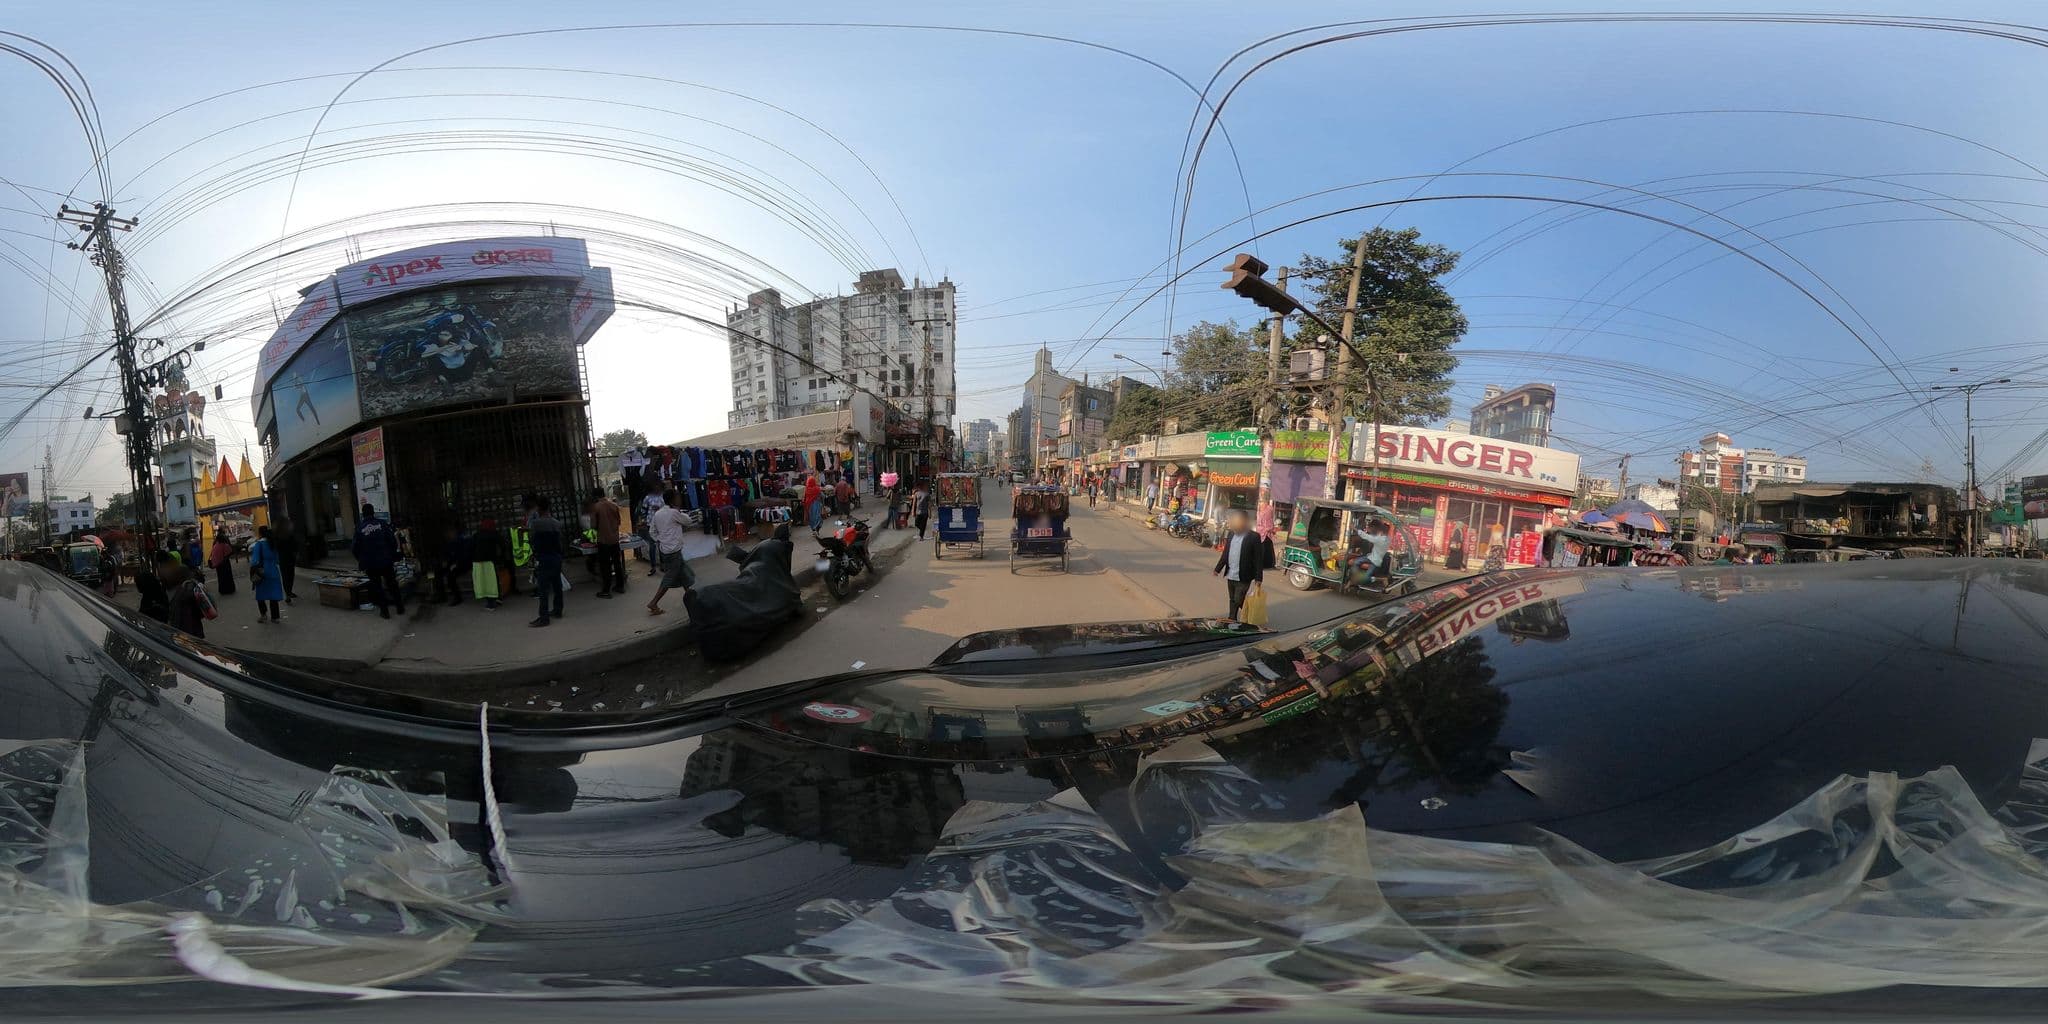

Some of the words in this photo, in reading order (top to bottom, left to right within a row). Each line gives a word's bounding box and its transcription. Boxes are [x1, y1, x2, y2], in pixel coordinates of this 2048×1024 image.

[362, 255, 444, 287] Apex
[1207, 436, 1234, 448] Green
[1377, 431, 1534, 479] SINGER
[1209, 472, 1234, 486] Green
